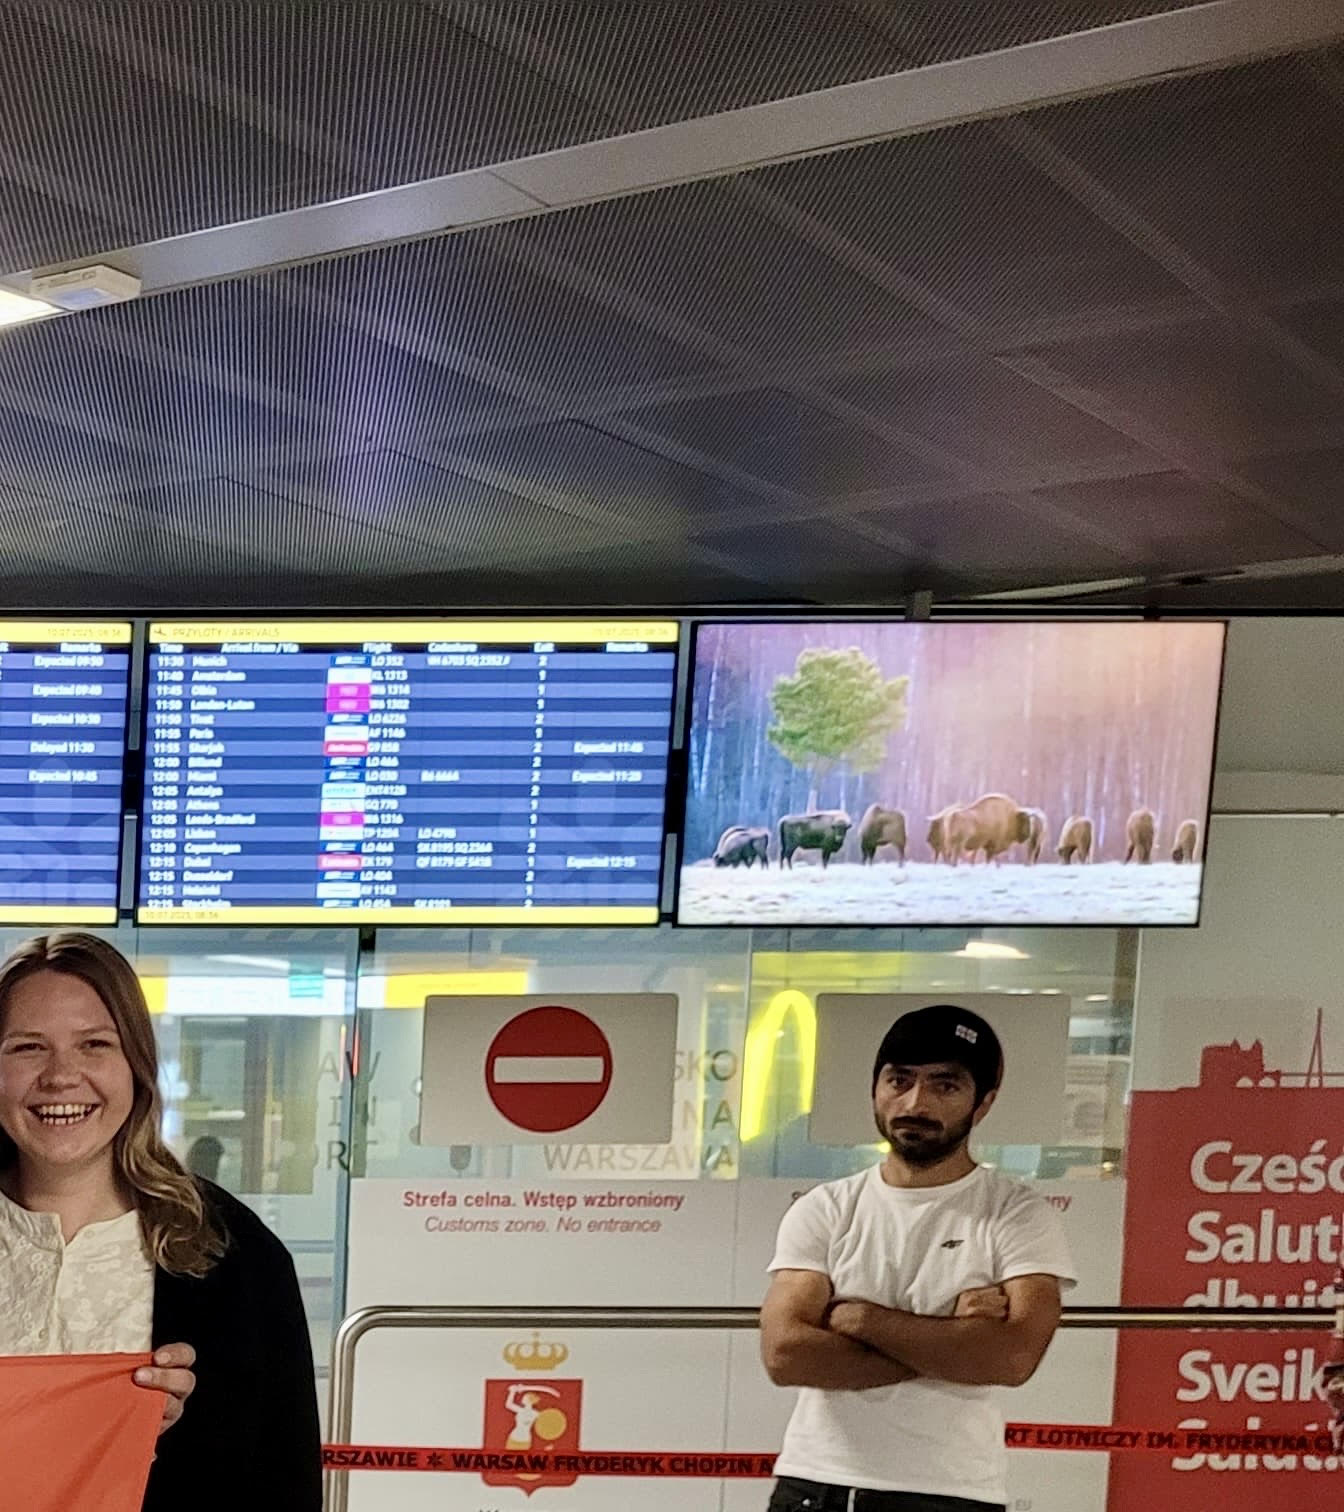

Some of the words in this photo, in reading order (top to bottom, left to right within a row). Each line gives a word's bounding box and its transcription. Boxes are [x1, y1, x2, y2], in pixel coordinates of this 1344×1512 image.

[403, 1191, 457, 1207] Strefa
[463, 1191, 517, 1207] celna.
[524, 1191, 577, 1211] Wstęp
[583, 1191, 685, 1212] wzbroniony
[424, 1216, 499, 1232] Customs
[504, 1219, 549, 1232] zone.
[556, 1216, 582, 1232] No
[587, 1217, 662, 1232] entrance
[1185, 1208, 1344, 1264] Salut
[1041, 1427, 1139, 1447] LOTNICZY
[1186, 1432, 1311, 1450] FRYDERYKA
[453, 1453, 547, 1472] WARSAW
[554, 1456, 663, 1474] FRYDERYK
[670, 1457, 751, 1475] CHOPIN
